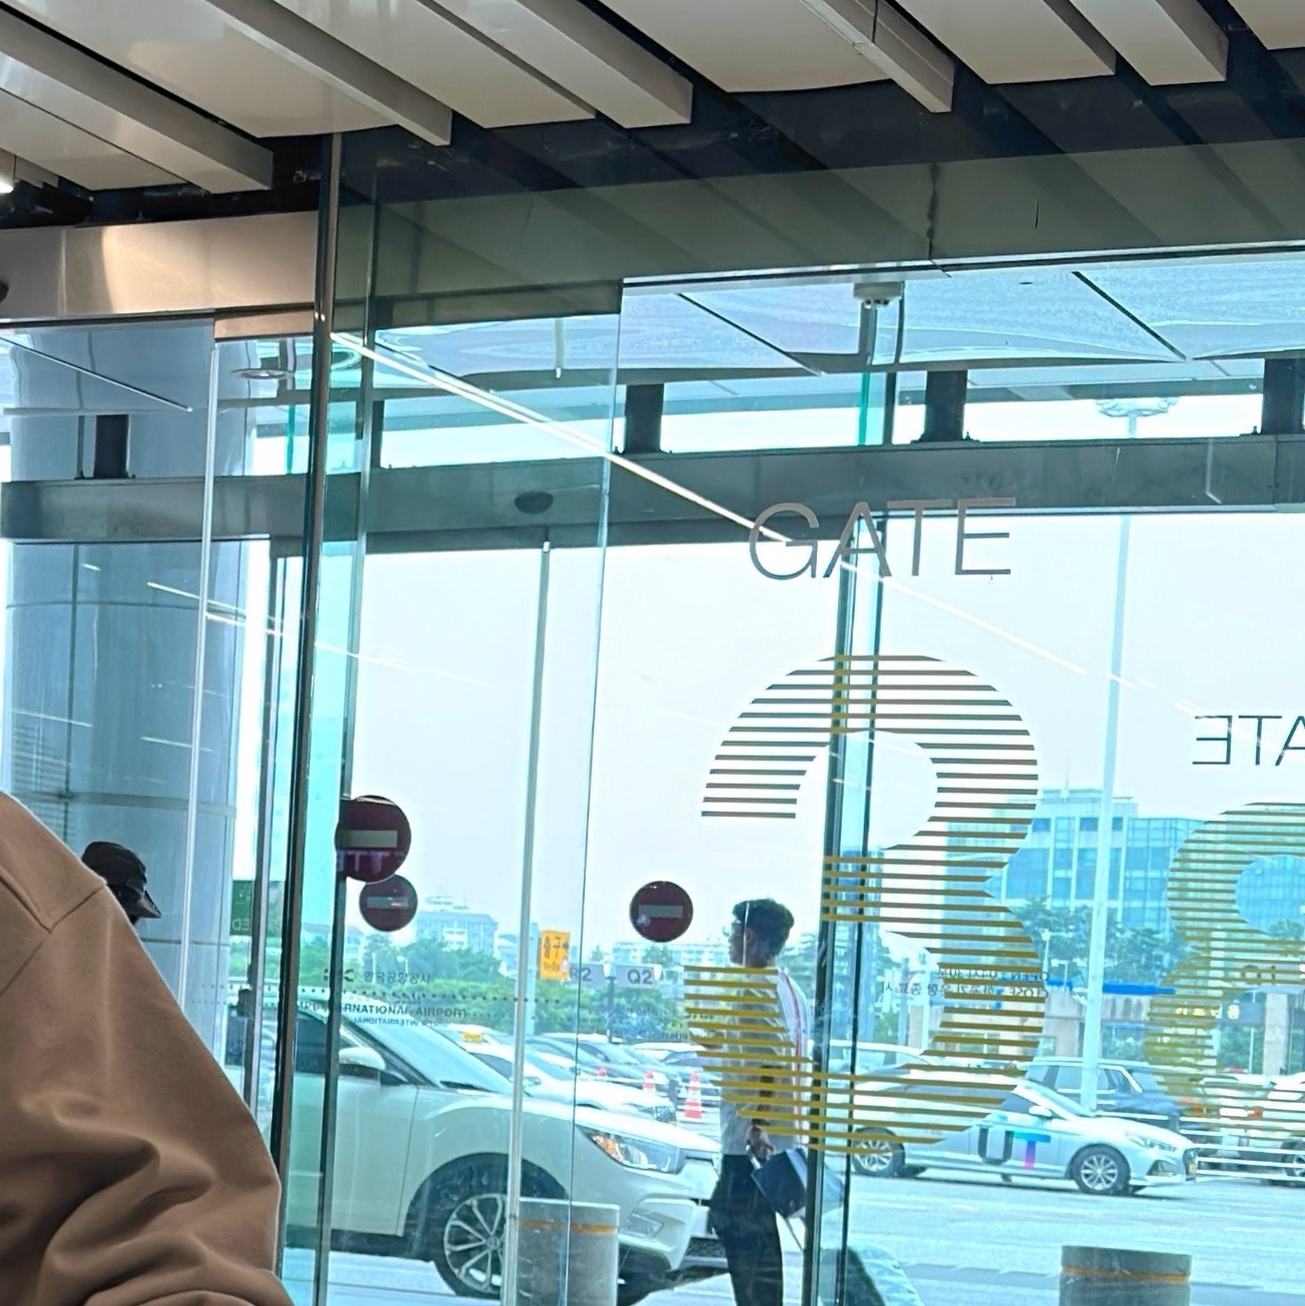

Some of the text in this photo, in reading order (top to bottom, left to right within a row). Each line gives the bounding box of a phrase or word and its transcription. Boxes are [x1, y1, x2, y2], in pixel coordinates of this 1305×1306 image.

[749, 497, 1016, 580] GATE
[683, 655, 1045, 1155] 3
[627, 968, 653, 985] Q2
